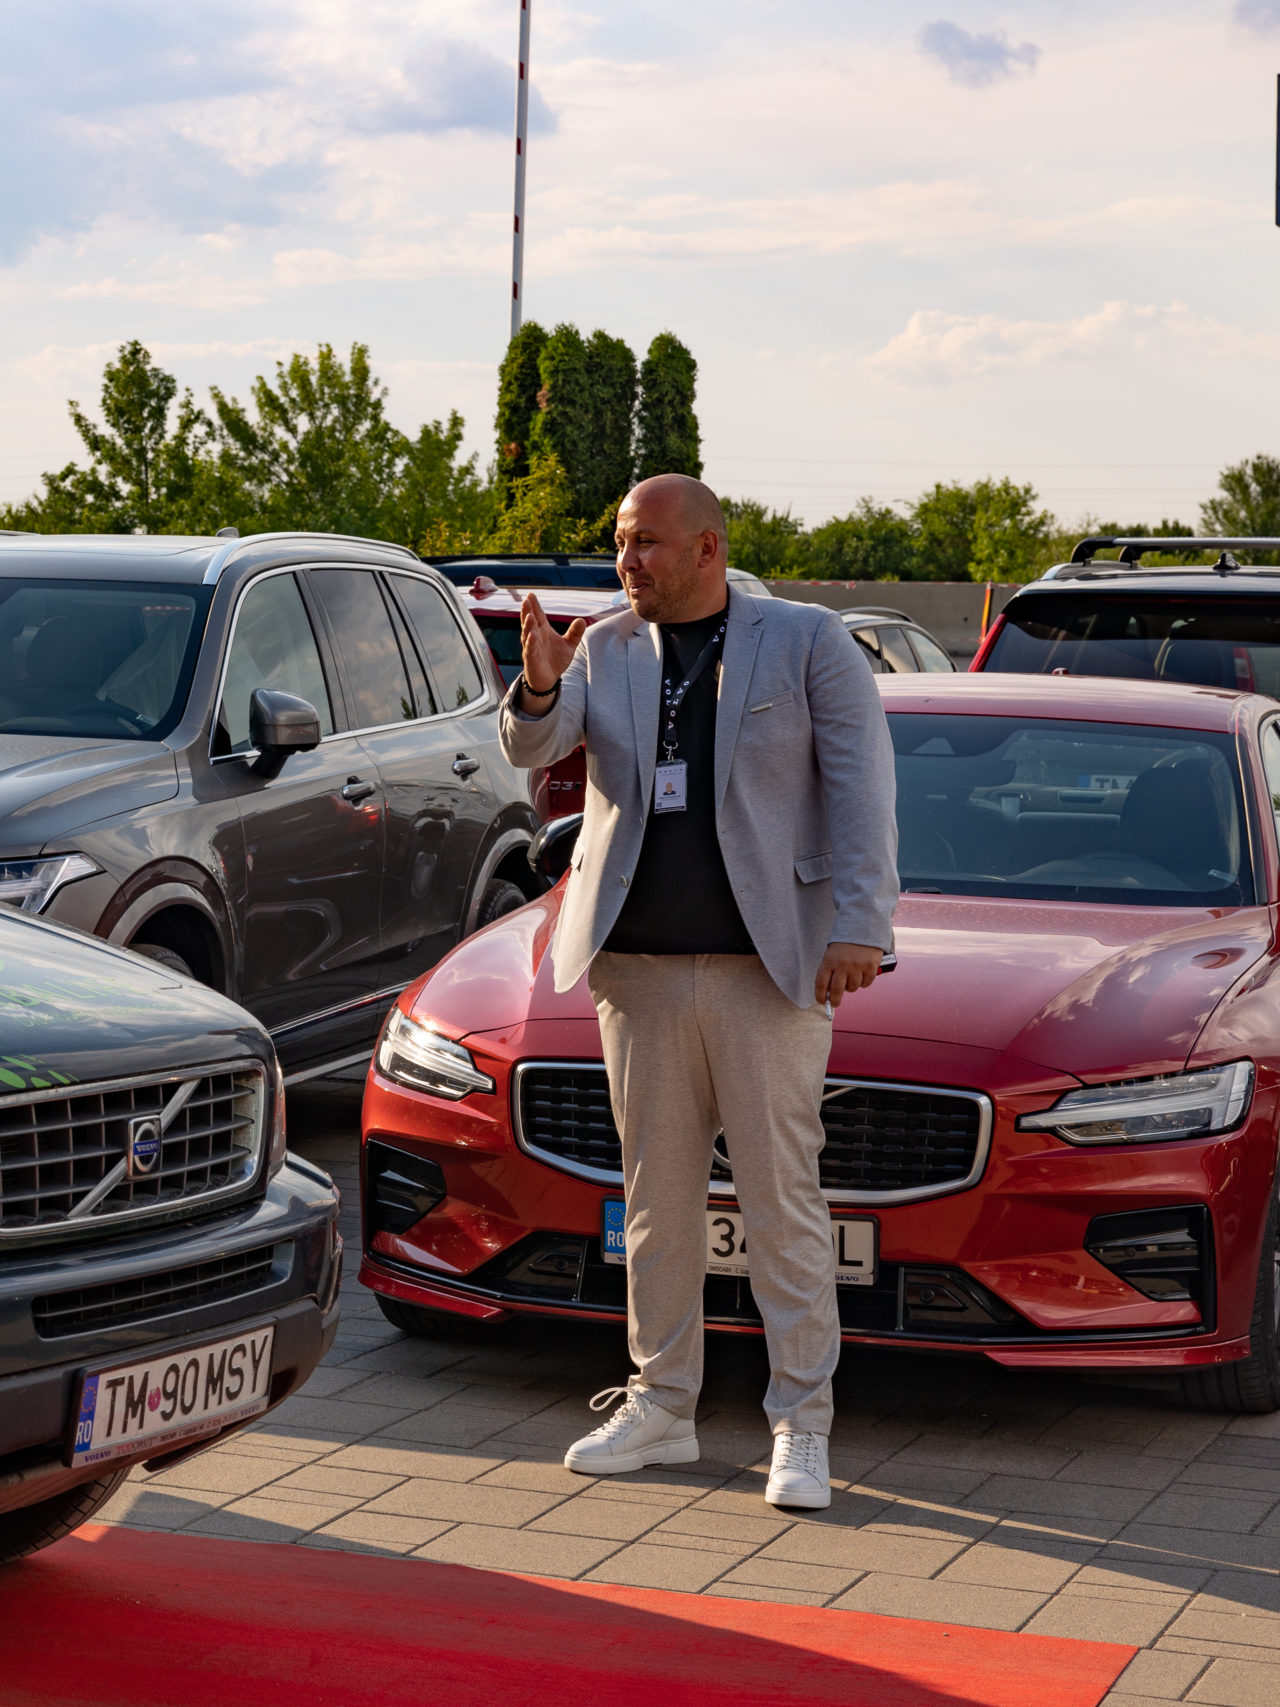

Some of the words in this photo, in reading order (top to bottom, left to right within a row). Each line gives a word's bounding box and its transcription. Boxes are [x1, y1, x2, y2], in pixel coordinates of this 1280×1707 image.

[136, 1142, 159, 1152] VOLVO
[607, 1229, 625, 1248] RO
[75, 1420, 93, 1446] RO
[105, 1370, 149, 1437] TM
[203, 1334, 269, 1410] MSY
[84, 1450, 111, 1462] VOLVO
